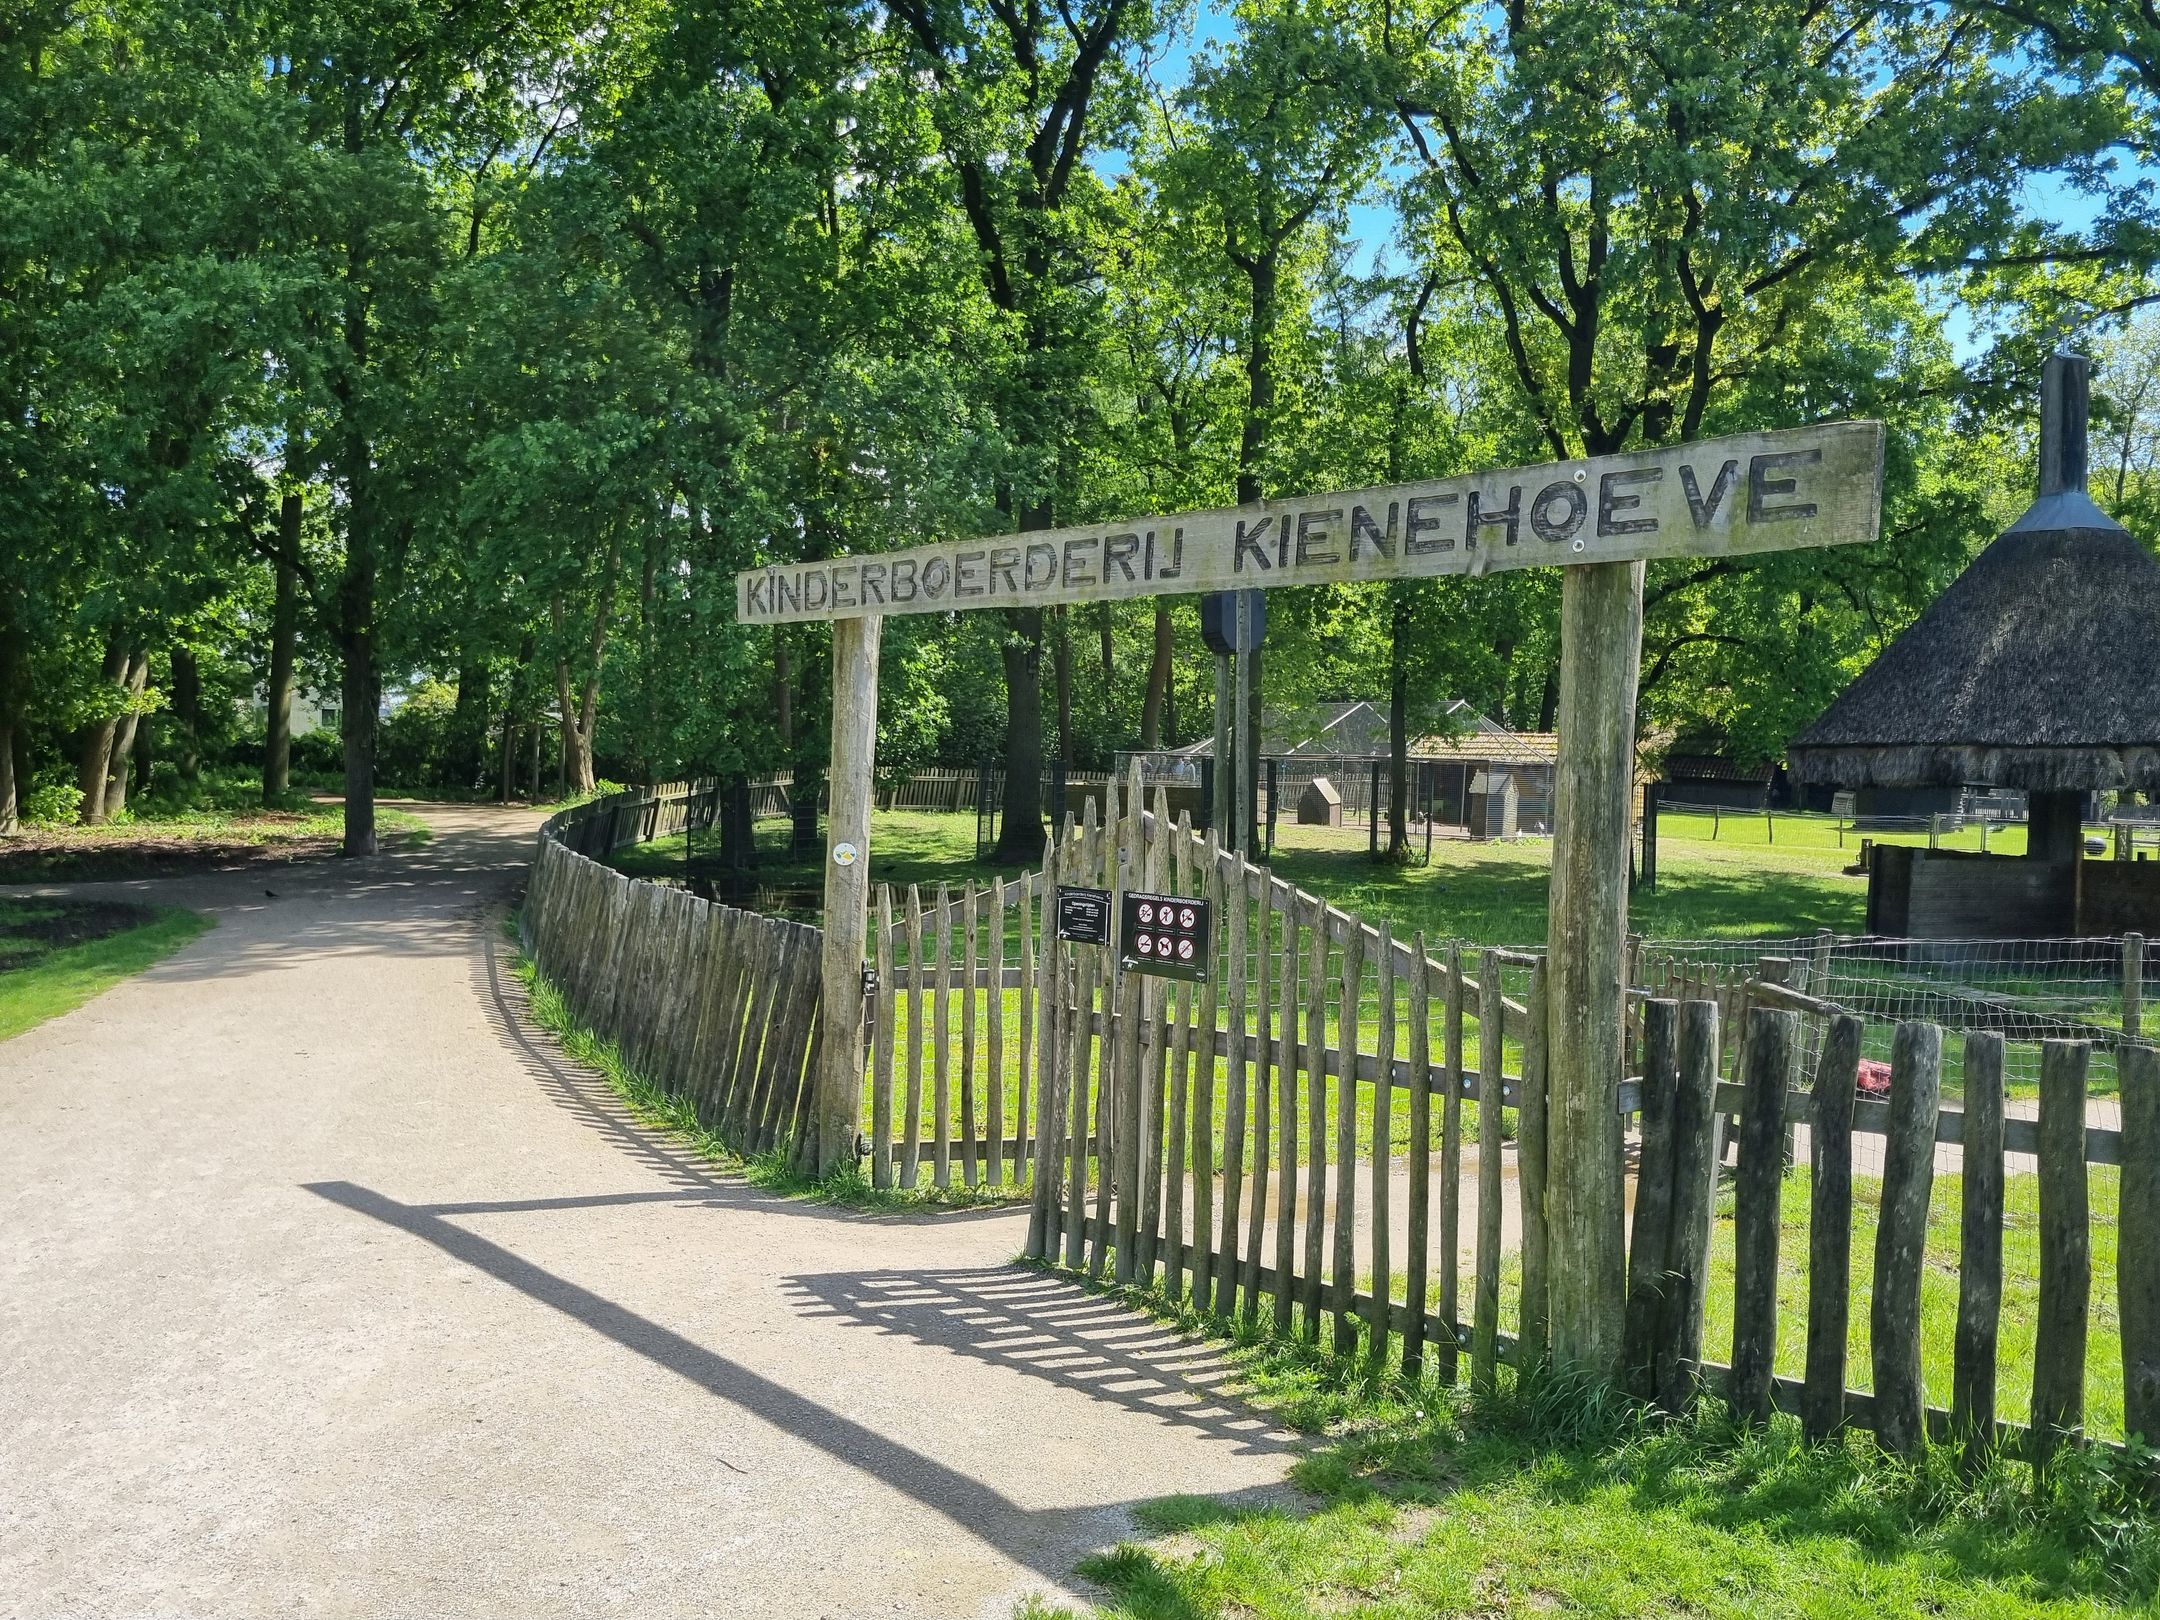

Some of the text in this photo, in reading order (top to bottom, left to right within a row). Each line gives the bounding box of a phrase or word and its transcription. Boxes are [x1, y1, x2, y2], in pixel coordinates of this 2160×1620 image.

[747, 449, 1823, 617] KINDERBOERDERIJ KIENEHOEVE
[1128, 893, 1204, 906] GEDRAGSREGELS KINDERBOERDERIJ
